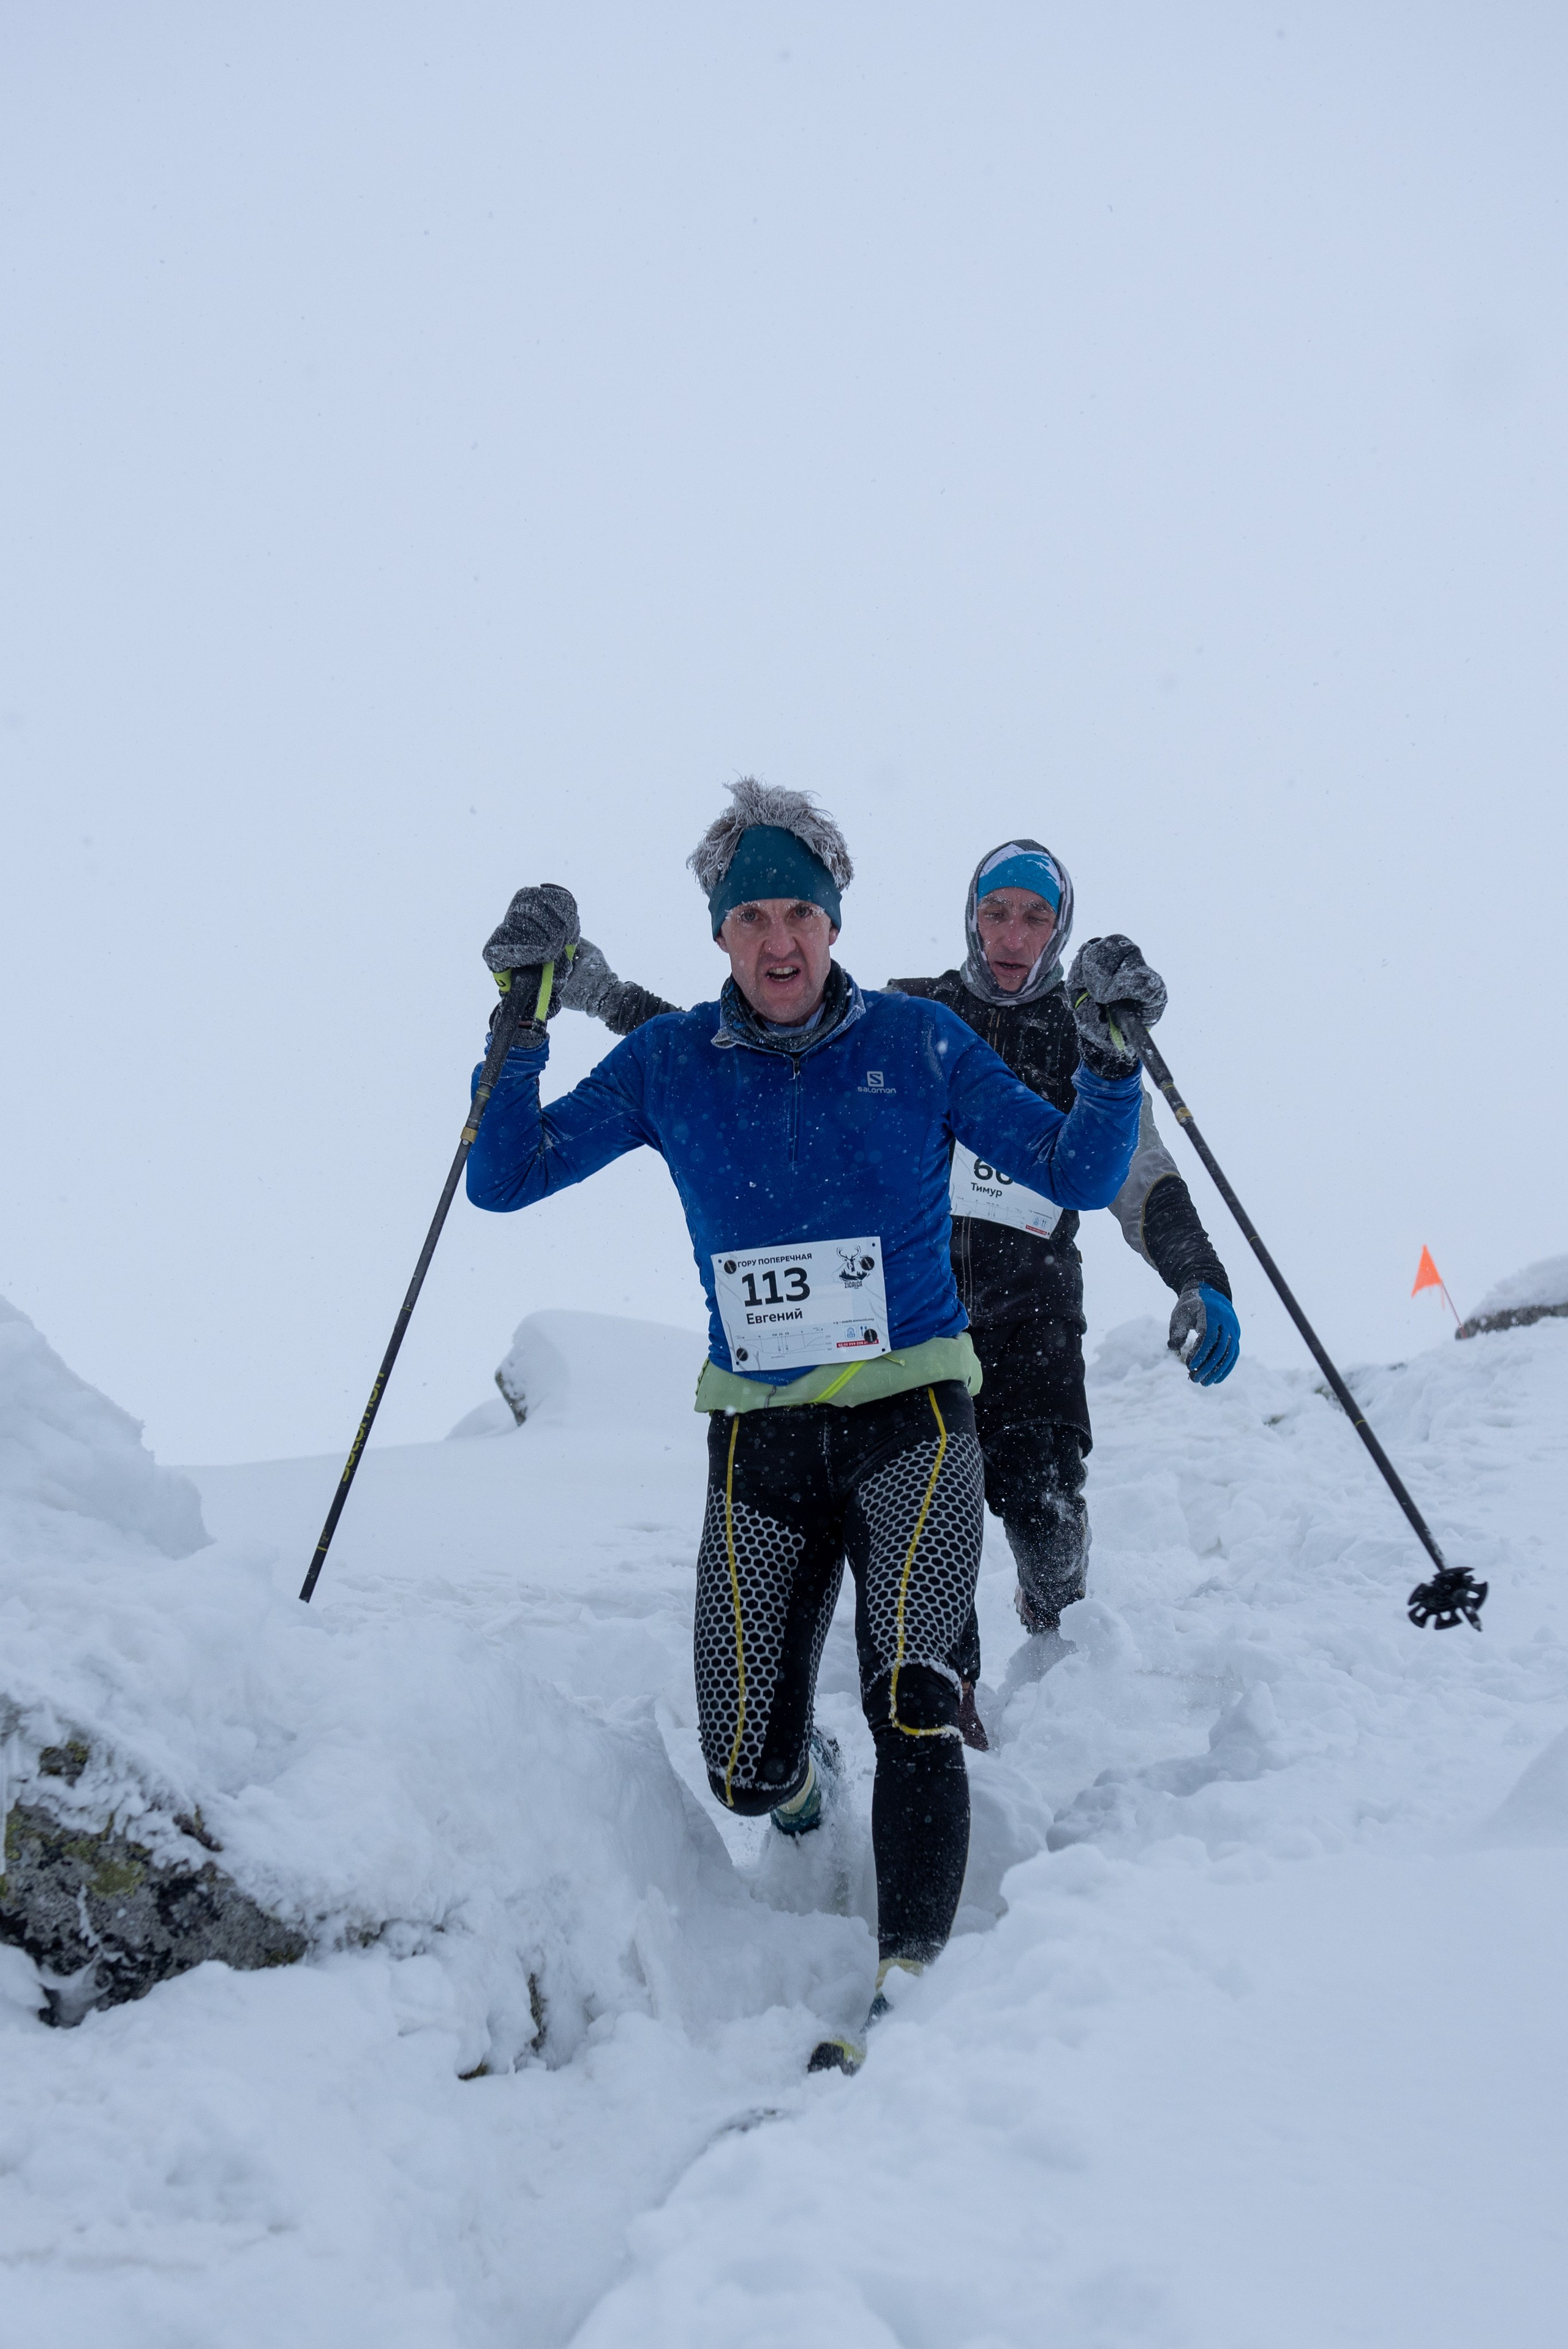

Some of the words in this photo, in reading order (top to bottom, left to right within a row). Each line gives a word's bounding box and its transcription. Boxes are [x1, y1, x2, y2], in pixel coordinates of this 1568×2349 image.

[971, 1182, 1003, 1198] Тимур
[737, 1259, 757, 1268] ГОРУ
[758, 1253, 813, 1265] ПОПЕРЕЧНАЯ
[742, 1267, 810, 1307] 113
[746, 1308, 803, 1325] Евгений
